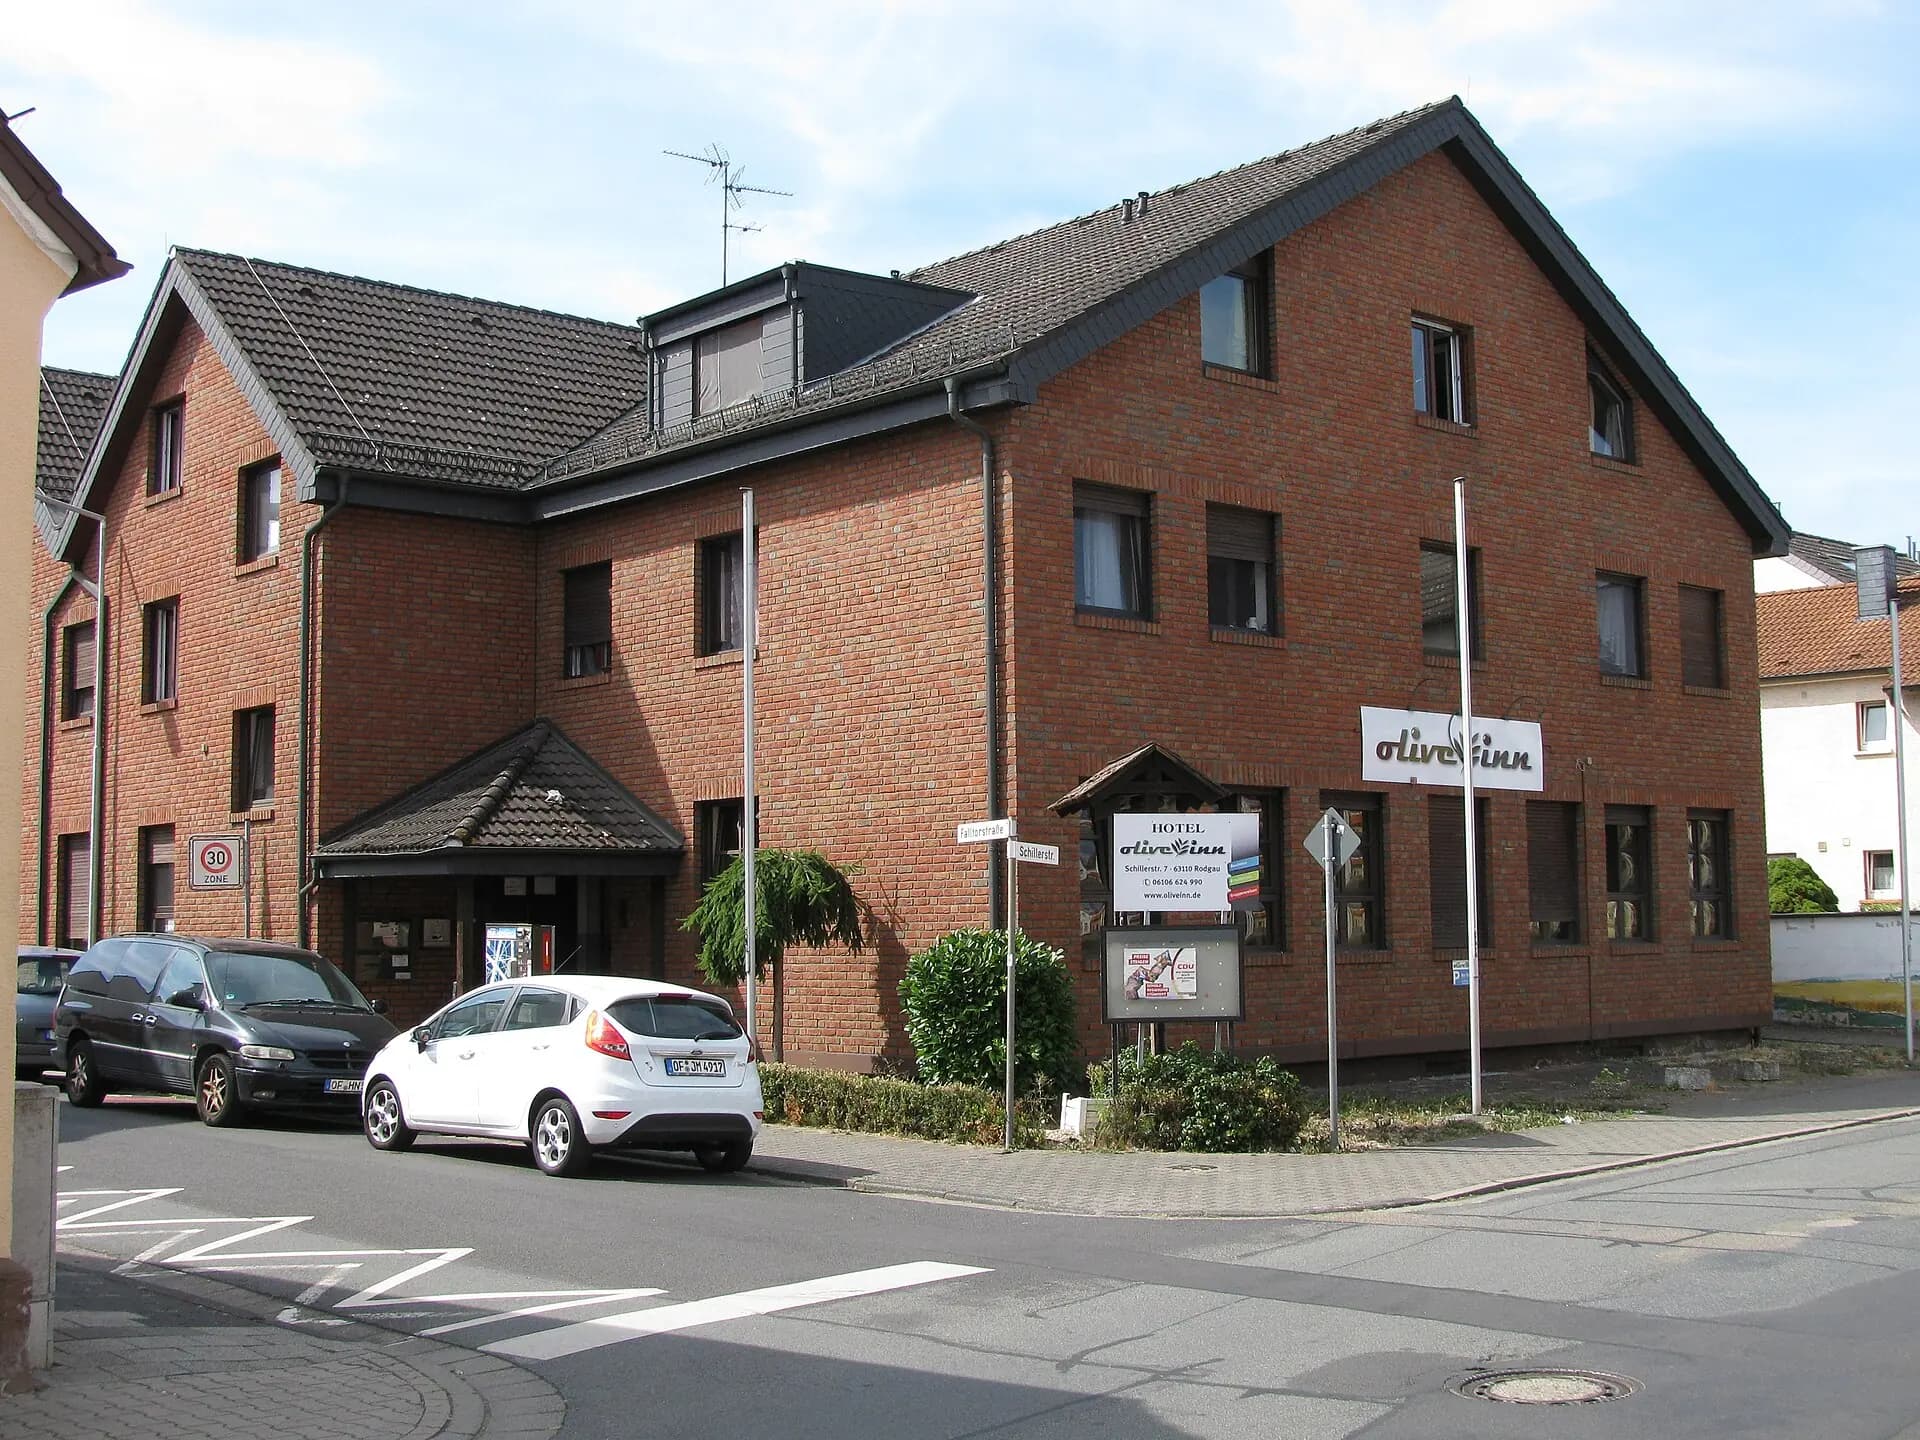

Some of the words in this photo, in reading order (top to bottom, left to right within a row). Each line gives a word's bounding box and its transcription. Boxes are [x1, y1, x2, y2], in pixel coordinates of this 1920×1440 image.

[1376, 727, 1457, 765] olive
[1480, 733, 1533, 770] inn
[1152, 823, 1205, 834] HOTEL
[1019, 845, 1055, 861] Schillerstr.
[1119, 840, 1173, 855] olive
[1189, 840, 1226, 855] inn
[207, 850, 226, 865] 30
[1124, 864, 1162, 873] Schillerstr.
[1163, 865, 1168, 873] 7
[1173, 865, 1193, 873] 63110
[1194, 864, 1221, 874] Rodgau
[204, 874, 229, 884] ZONE
[1143, 891, 1201, 899] www.oliveinn.de
[673, 1060, 684, 1072] OF
[703, 1062, 723, 1073] 4917
[331, 1080, 344, 1090] OF
